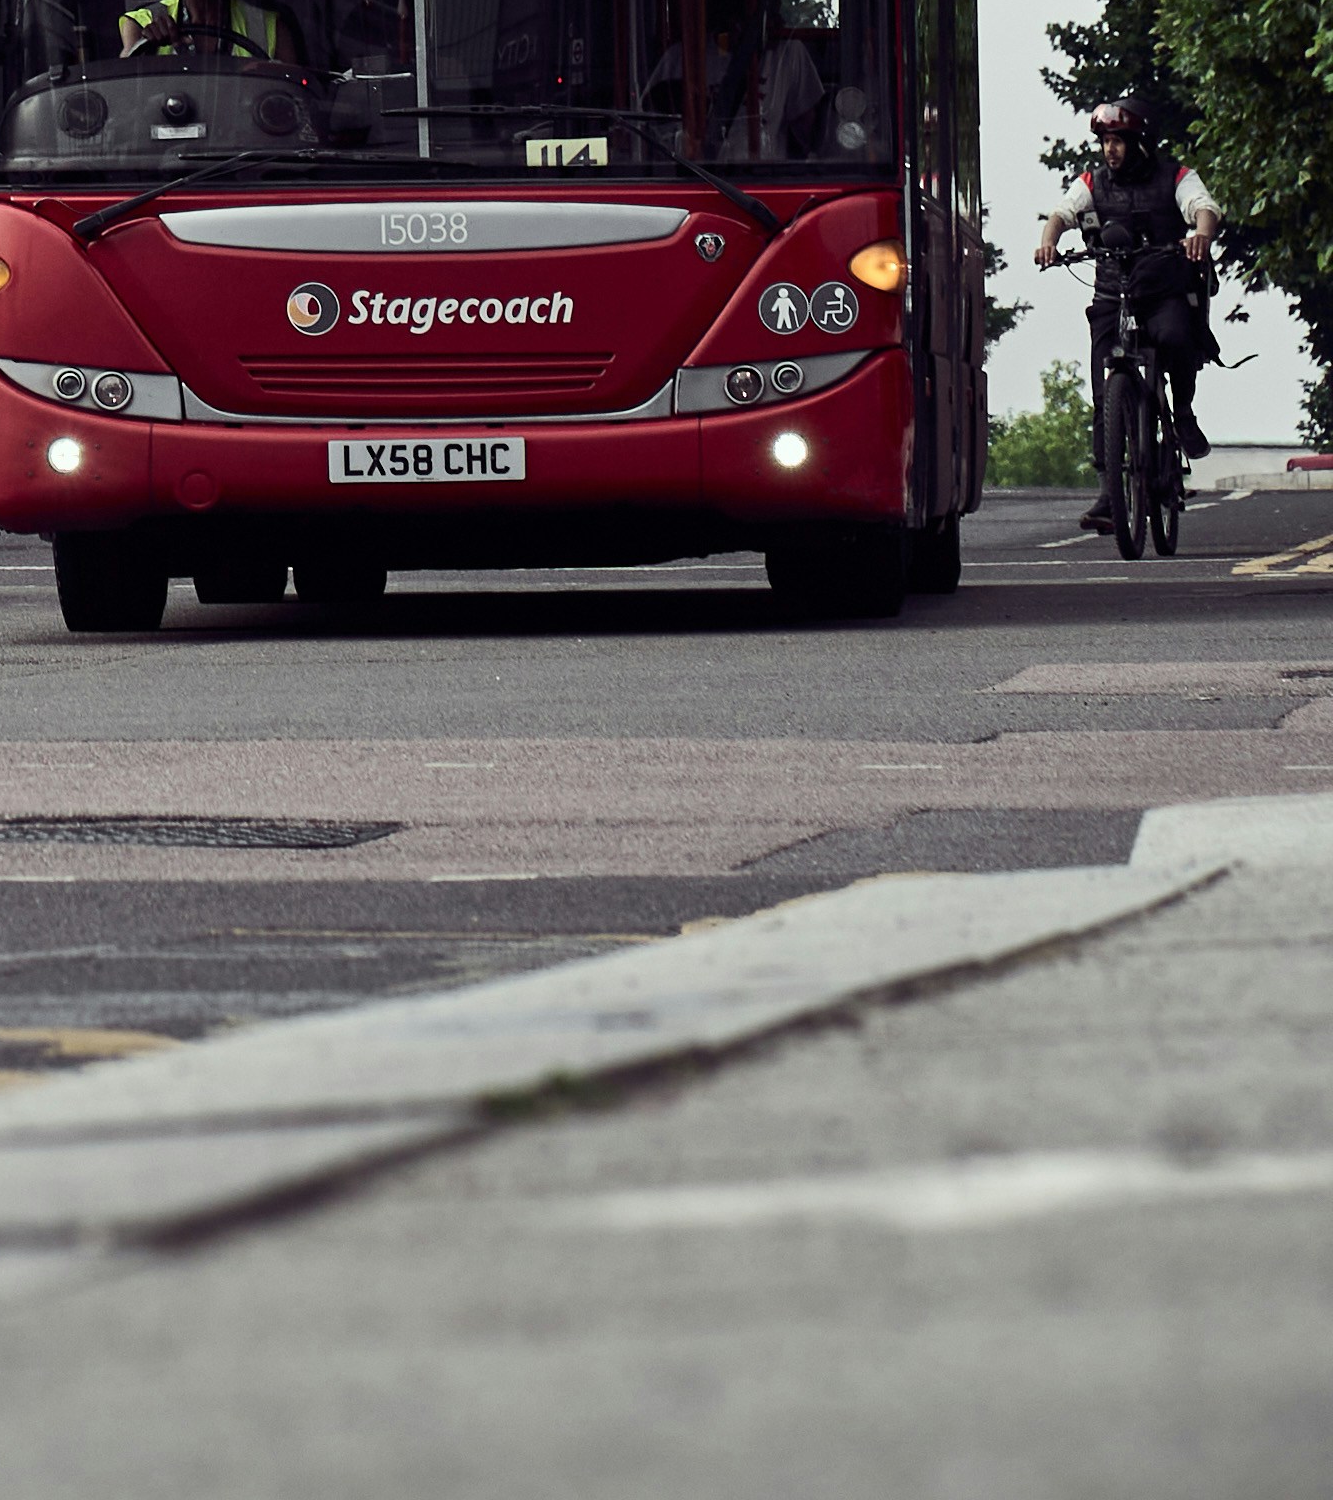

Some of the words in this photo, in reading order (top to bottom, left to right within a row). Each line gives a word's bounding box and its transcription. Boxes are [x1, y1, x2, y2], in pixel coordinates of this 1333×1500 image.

[380, 212, 469, 246] 15038
[347, 290, 574, 335] Stagecoach
[343, 444, 433, 477] LX58
[443, 442, 511, 476] CHC
